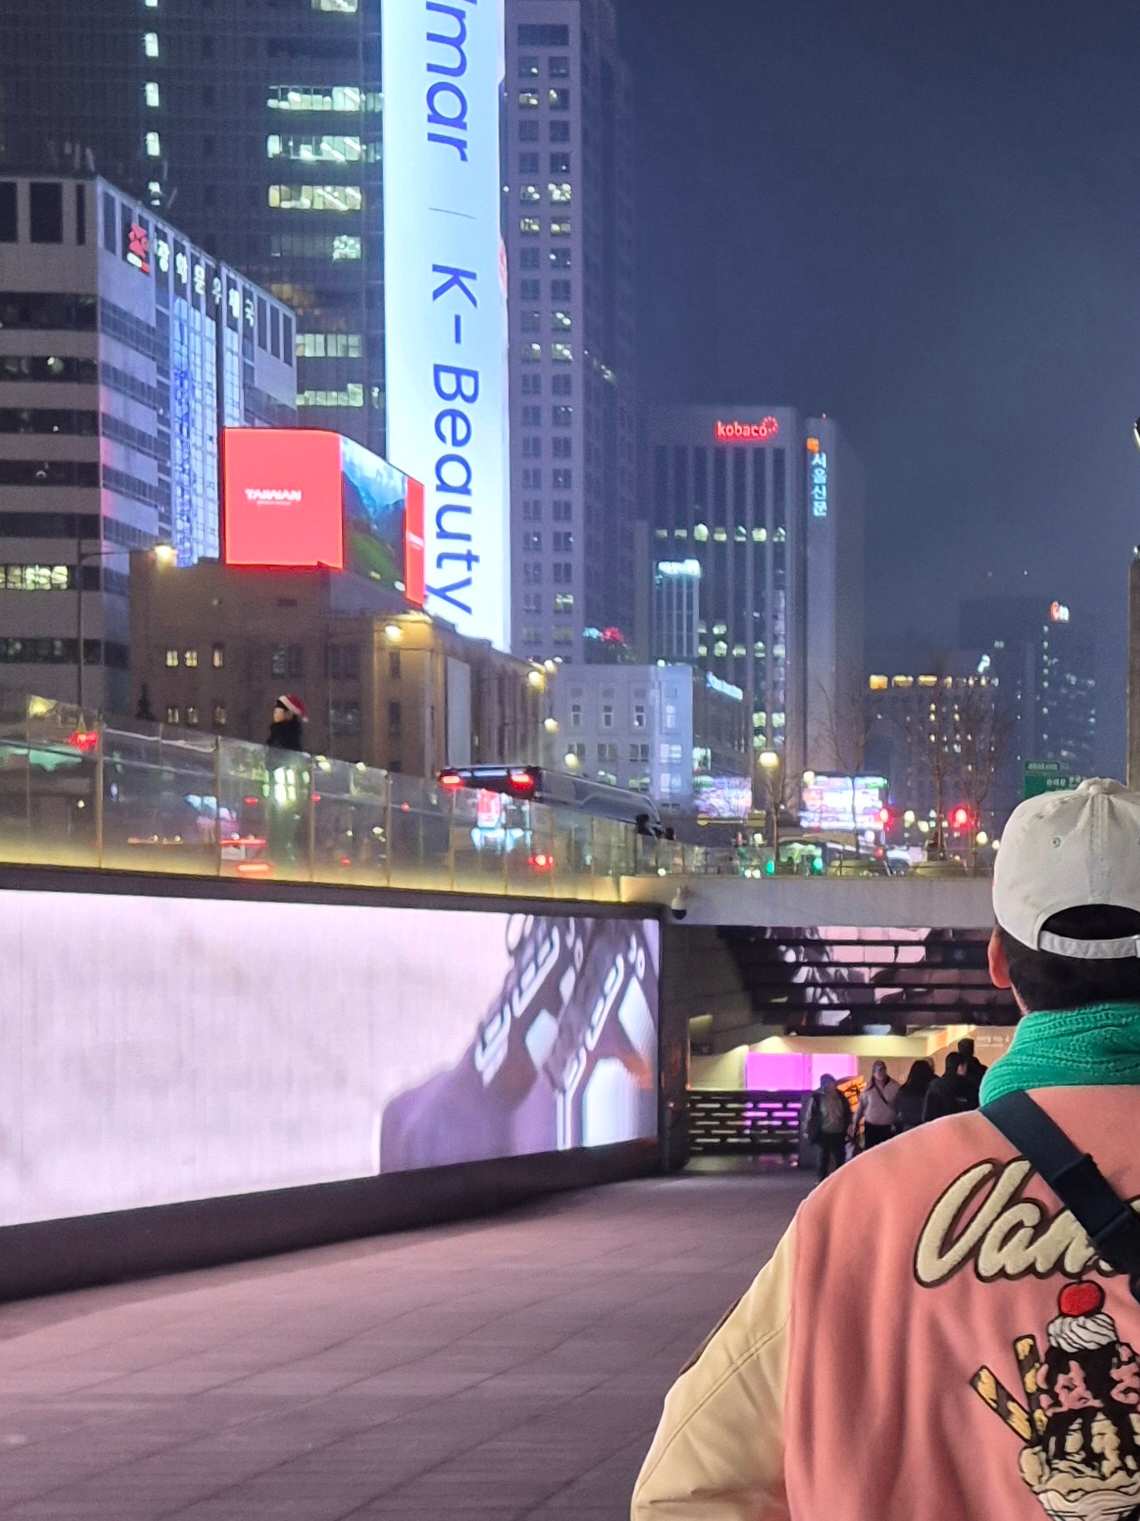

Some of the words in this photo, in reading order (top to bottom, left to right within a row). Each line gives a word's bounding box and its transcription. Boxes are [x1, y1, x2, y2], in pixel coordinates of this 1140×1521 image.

[426, 0, 478, 162] mar
[425, 263, 480, 615] K-Beauty
[717, 420, 767, 437] kobaco
[244, 488, 302, 501] TAIWAN
[811, 452, 827, 517] 서울신문
